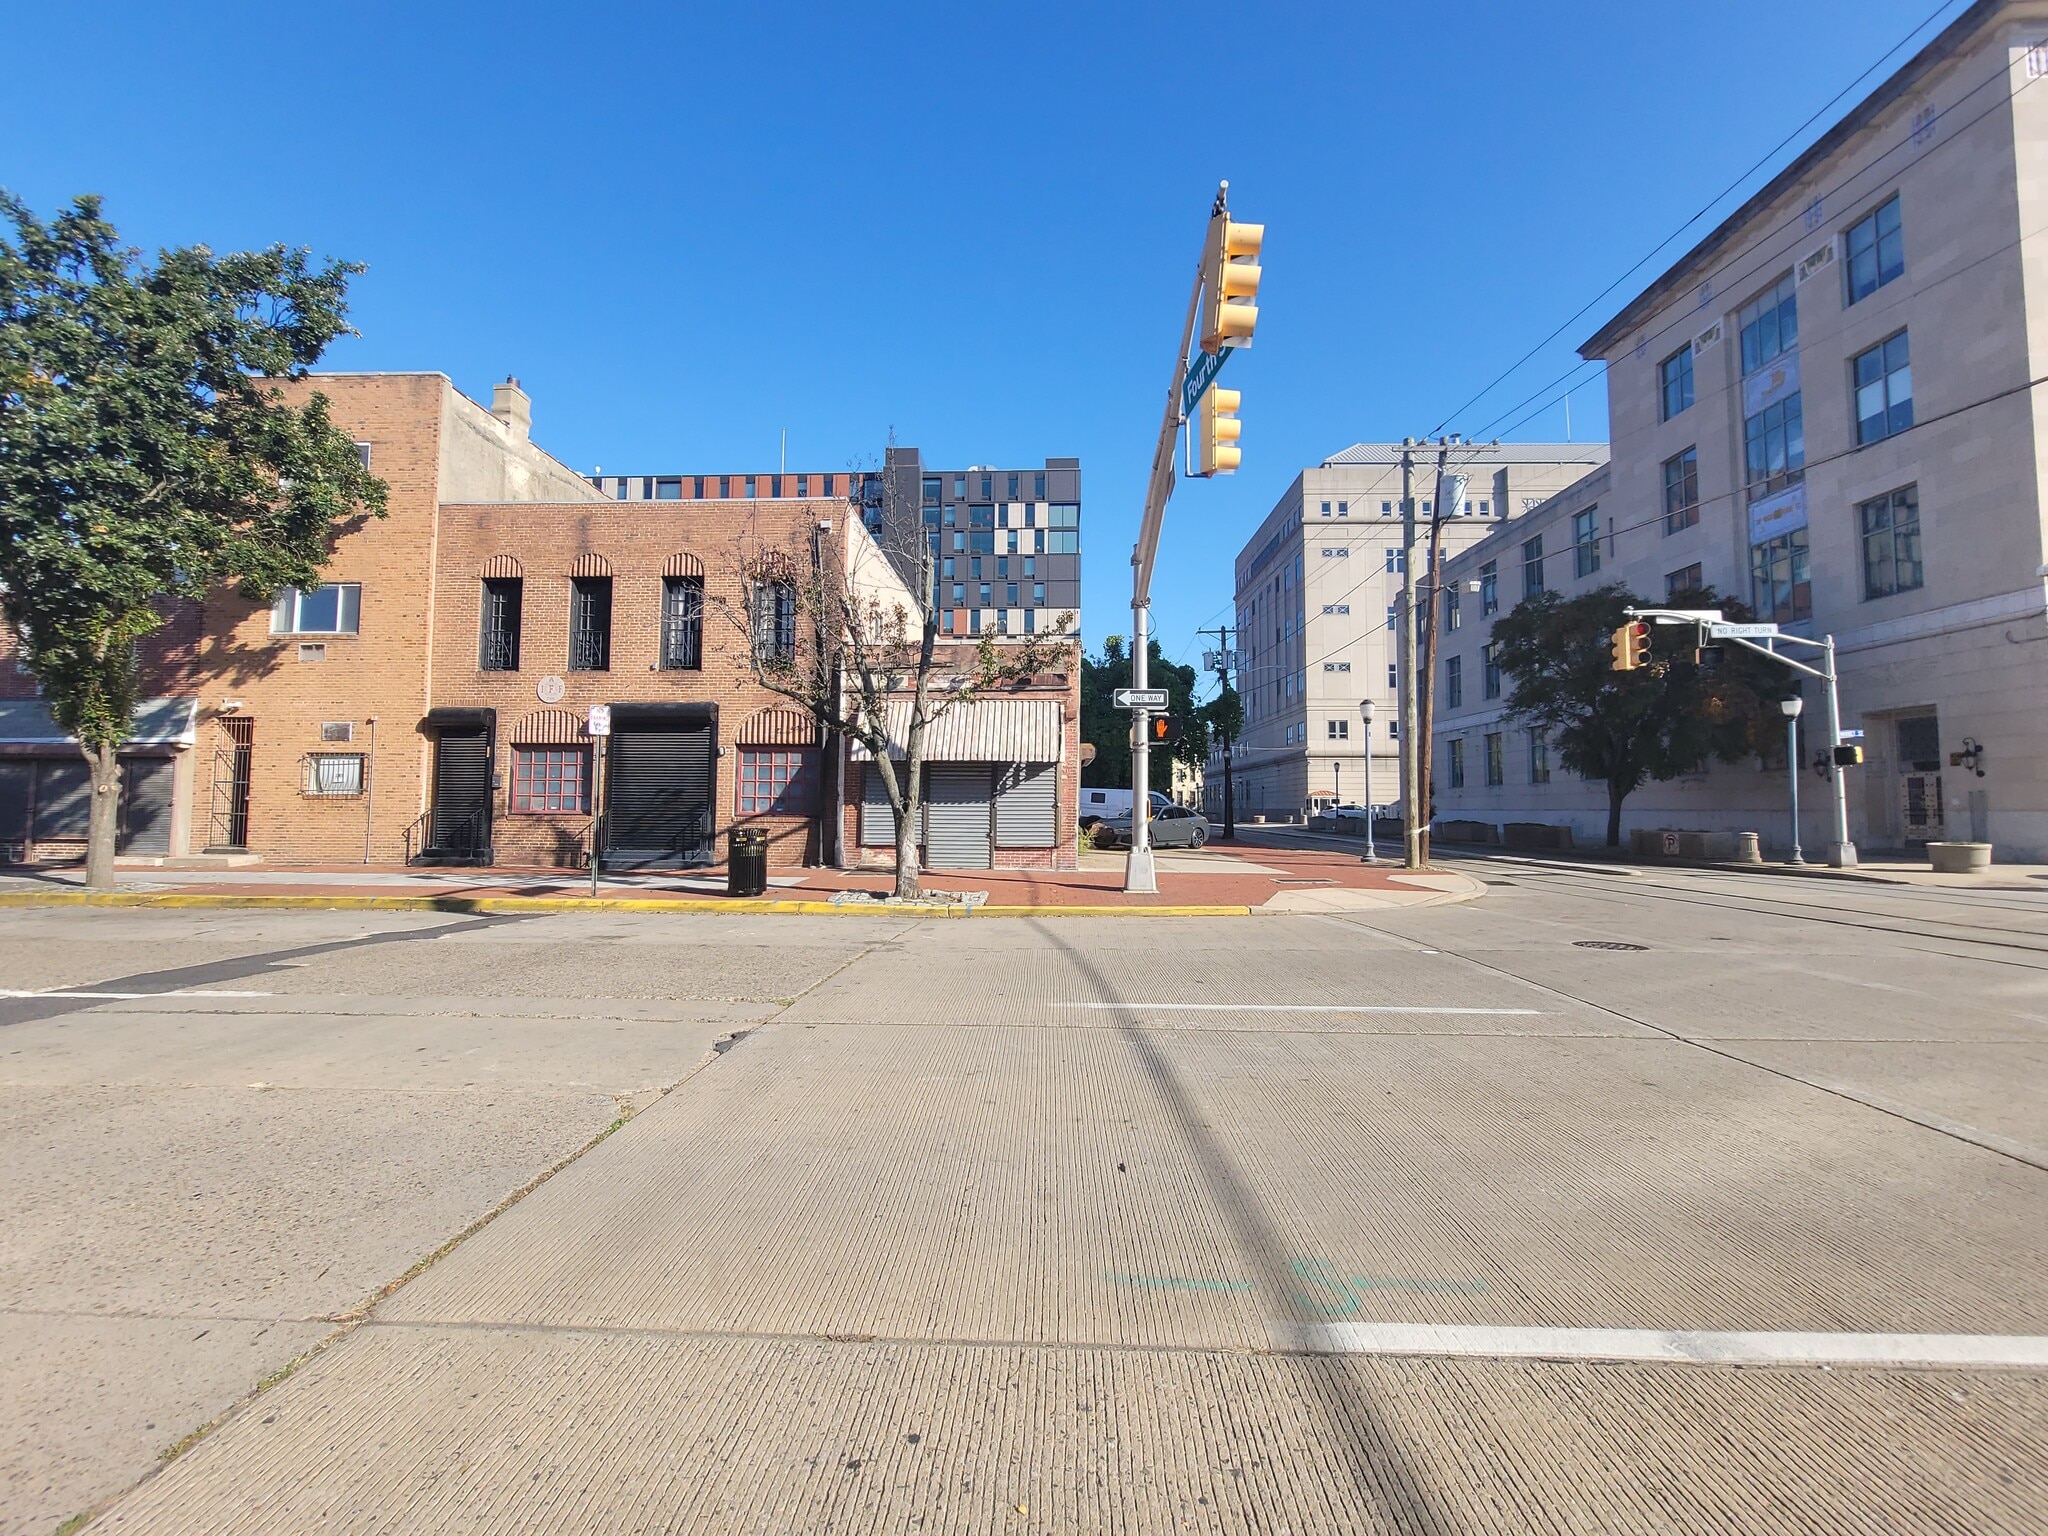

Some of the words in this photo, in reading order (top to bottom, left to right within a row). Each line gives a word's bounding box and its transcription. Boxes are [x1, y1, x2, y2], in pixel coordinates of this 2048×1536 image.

[1187, 354, 1217, 405] Fourth
[1717, 627, 1728, 635] NO
[1754, 626, 1772, 634] TURN
[1130, 694, 1146, 702] ONE
[1147, 694, 1162, 702] WAY
